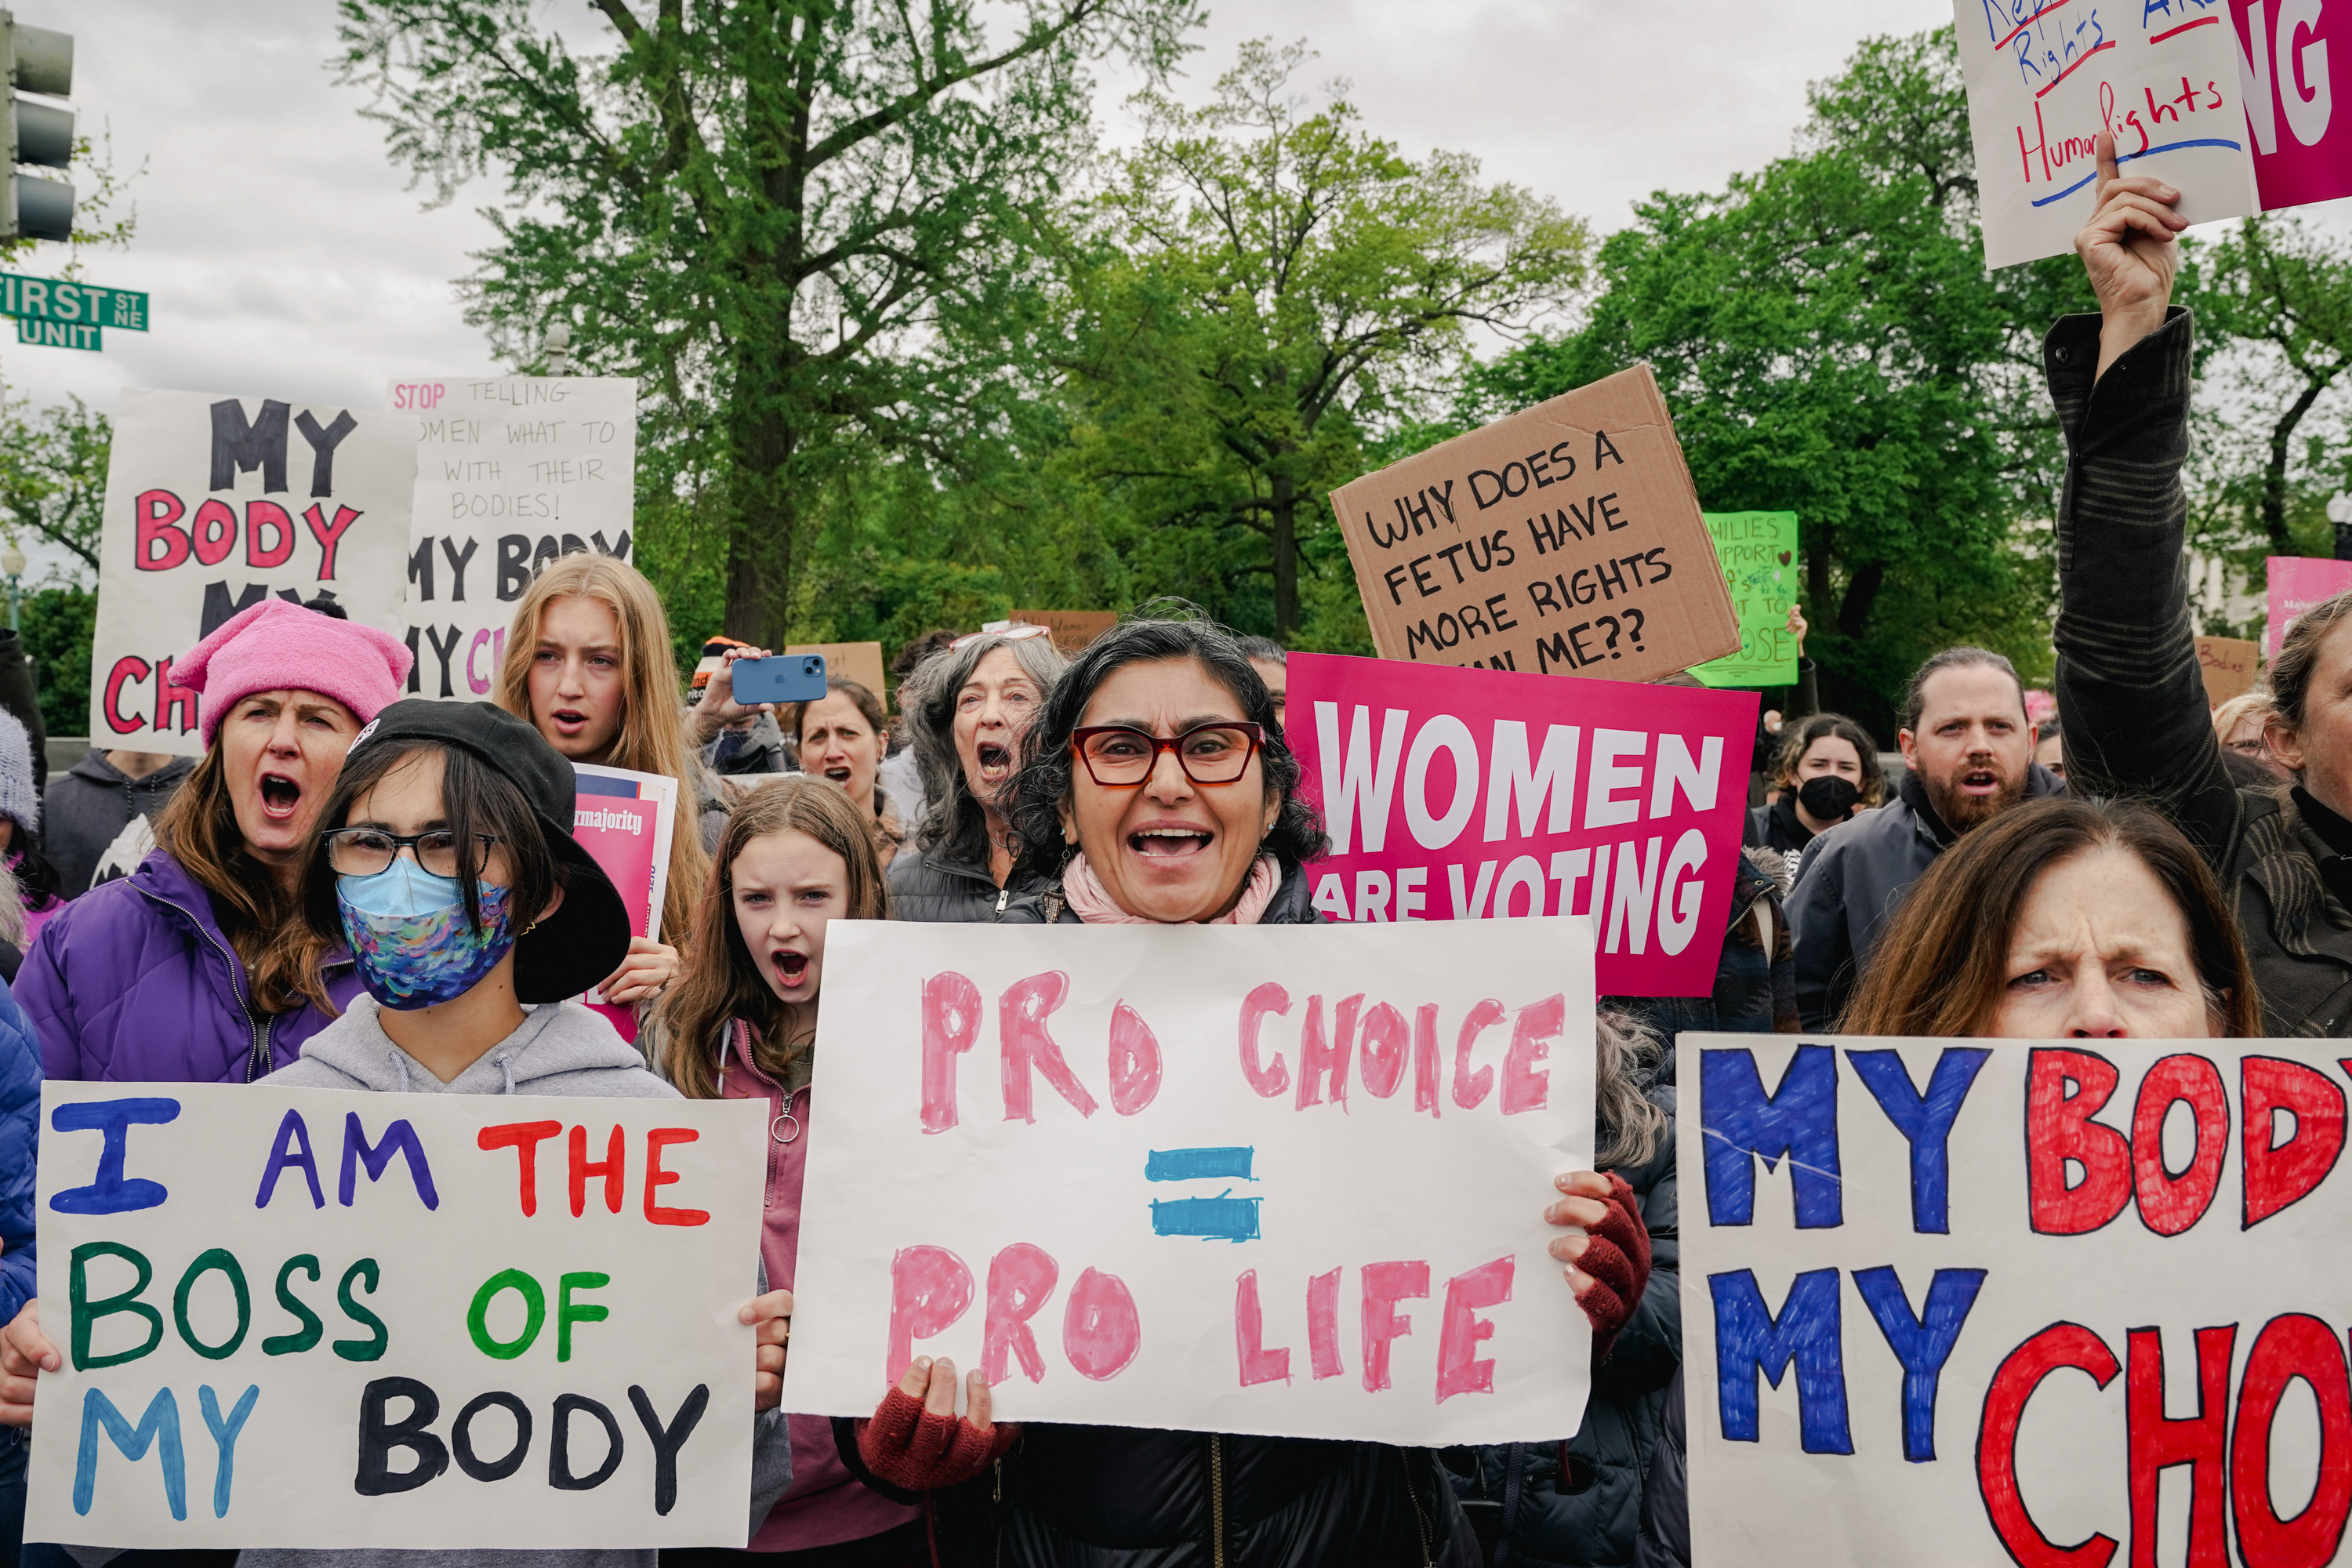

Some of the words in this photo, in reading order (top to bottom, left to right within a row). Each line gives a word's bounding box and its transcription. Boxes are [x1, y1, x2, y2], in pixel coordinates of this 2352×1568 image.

[2013, 8, 2104, 85] Rights
[2100, 76, 2223, 159] Rights
[0, 276, 108, 323] IRST
[115, 292, 140, 310] ST
[20, 318, 98, 350] UNIT
[114, 309, 143, 328] NE
[394, 383, 445, 409] STOP
[467, 382, 571, 406] TELLING
[418, 419, 480, 445] OMEN
[506, 420, 566, 445] WHAT
[581, 421, 615, 444] TO
[210, 398, 358, 498] MY
[444, 459, 503, 482] WITH
[528, 459, 604, 484] THEIR
[452, 492, 560, 521] BODIES!
[1366, 479, 1461, 550] WHY
[1467, 441, 1576, 511] DOES
[1595, 430, 1624, 470] A
[1710, 517, 1780, 541] MILIES
[134, 489, 365, 581] BODY
[404, 535, 479, 604] MY
[1384, 530, 1515, 605] FETUS
[1526, 493, 1628, 555] HAVE
[1719, 543, 1779, 565] PPORT
[1406, 593, 1518, 660] MORE
[1528, 546, 1672, 618] RIGHTS
[1536, 608, 1646, 674] ME??
[1762, 598, 1788, 615] TO
[1313, 700, 1725, 856] WOMEN
[575, 807, 643, 837] rmajority
[1312, 866, 1428, 922] ARE
[1448, 828, 1708, 956] VOTING
[1239, 982, 1566, 1119] CHOICE
[49, 1097, 181, 1215] I
[255, 1109, 439, 1211] AM
[477, 1120, 710, 1226] THE
[1700, 1044, 1993, 1235] MY
[2025, 1046, 2352, 1238] BOD
[70, 1241, 389, 1371] BOSS
[467, 1268, 611, 1363] OF
[886, 1243, 1141, 1389] PRO
[1236, 1254, 1515, 1406] LIFE
[72, 1384, 260, 1521] MY
[354, 1377, 710, 1517] BODY
[1707, 1264, 1989, 1463] MY
[1974, 1312, 2352, 1568] CHO
